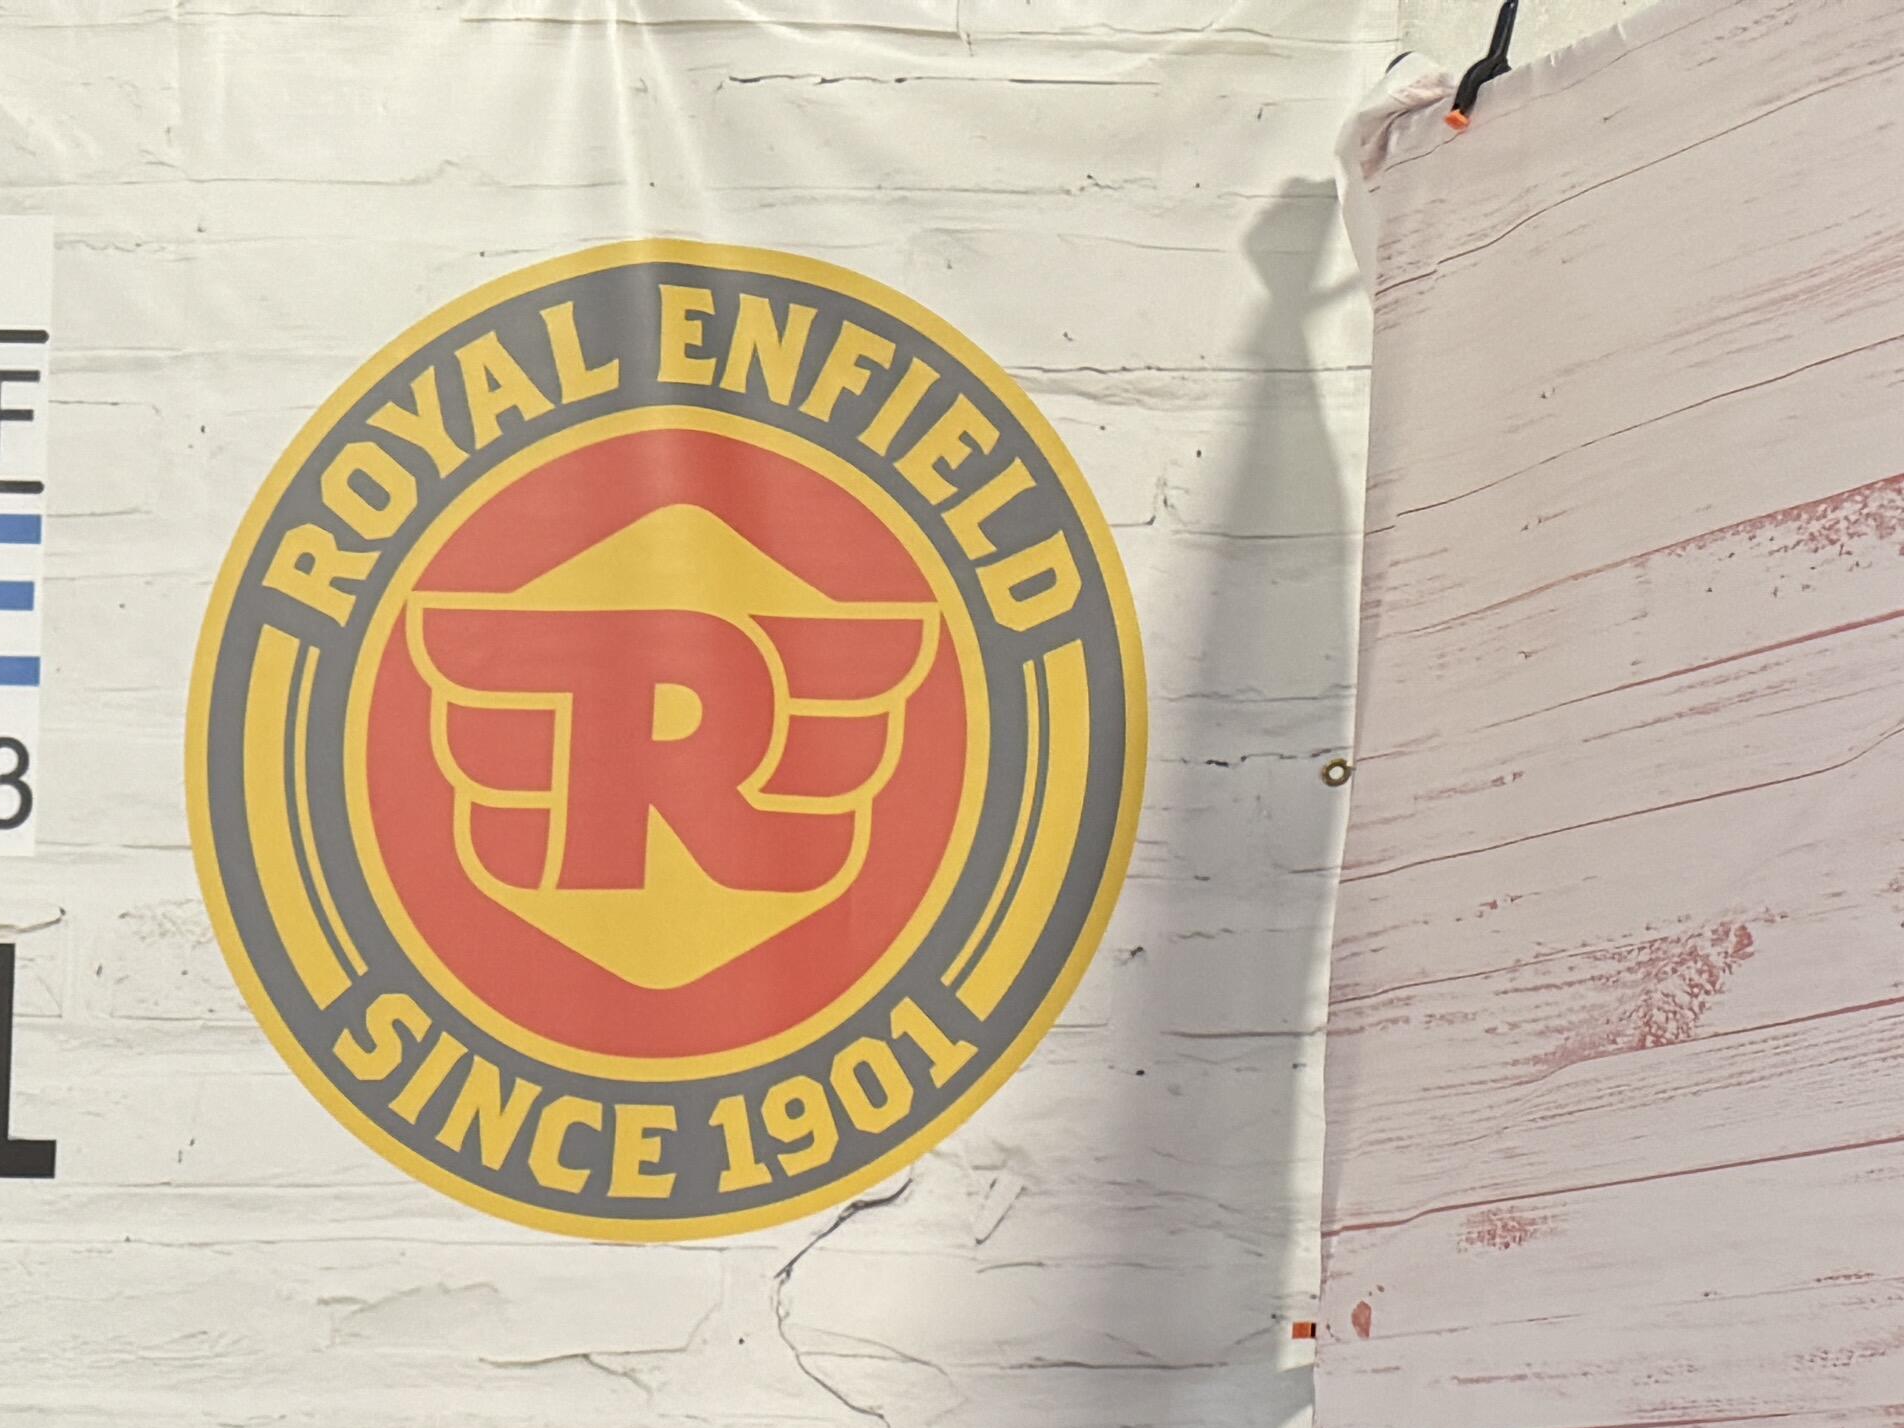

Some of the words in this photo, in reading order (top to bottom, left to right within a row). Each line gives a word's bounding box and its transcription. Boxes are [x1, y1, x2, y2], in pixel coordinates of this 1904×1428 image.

[263, 301, 622, 626] ROYAL
[657, 283, 1084, 634] ENFIELD
[334, 992, 680, 1199] SINCE
[710, 995, 980, 1194] 1901
